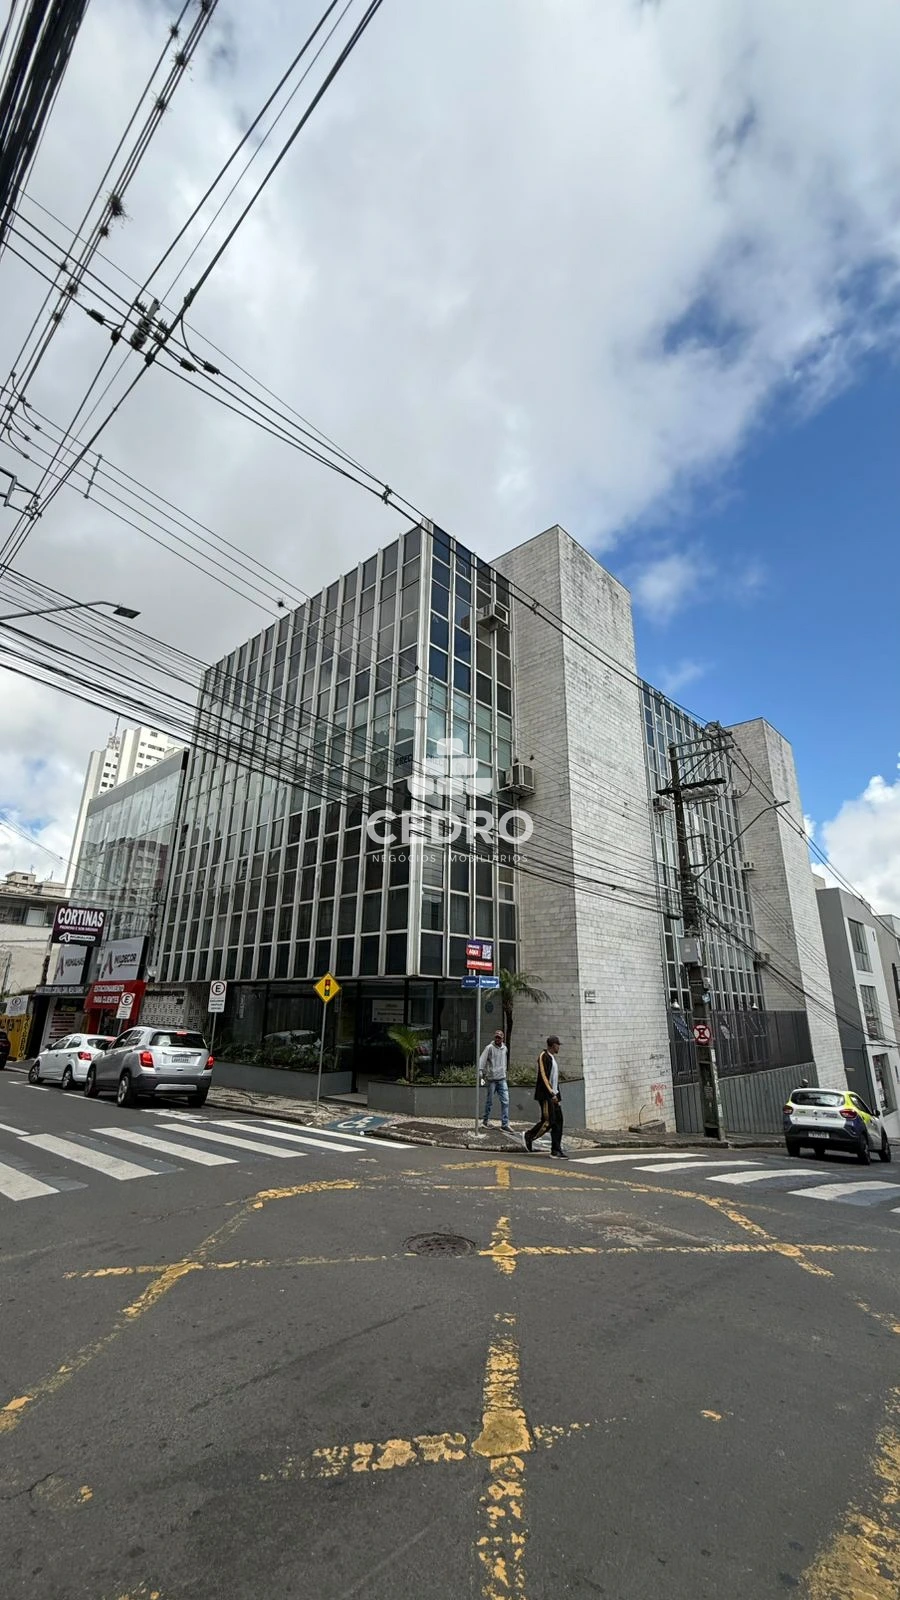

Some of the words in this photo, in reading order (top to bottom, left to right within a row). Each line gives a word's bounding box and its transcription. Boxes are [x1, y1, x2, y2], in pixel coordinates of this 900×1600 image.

[57, 908, 104, 928] CORTINAS
[215, 984, 222, 993] E
[124, 995, 130, 1004] E
